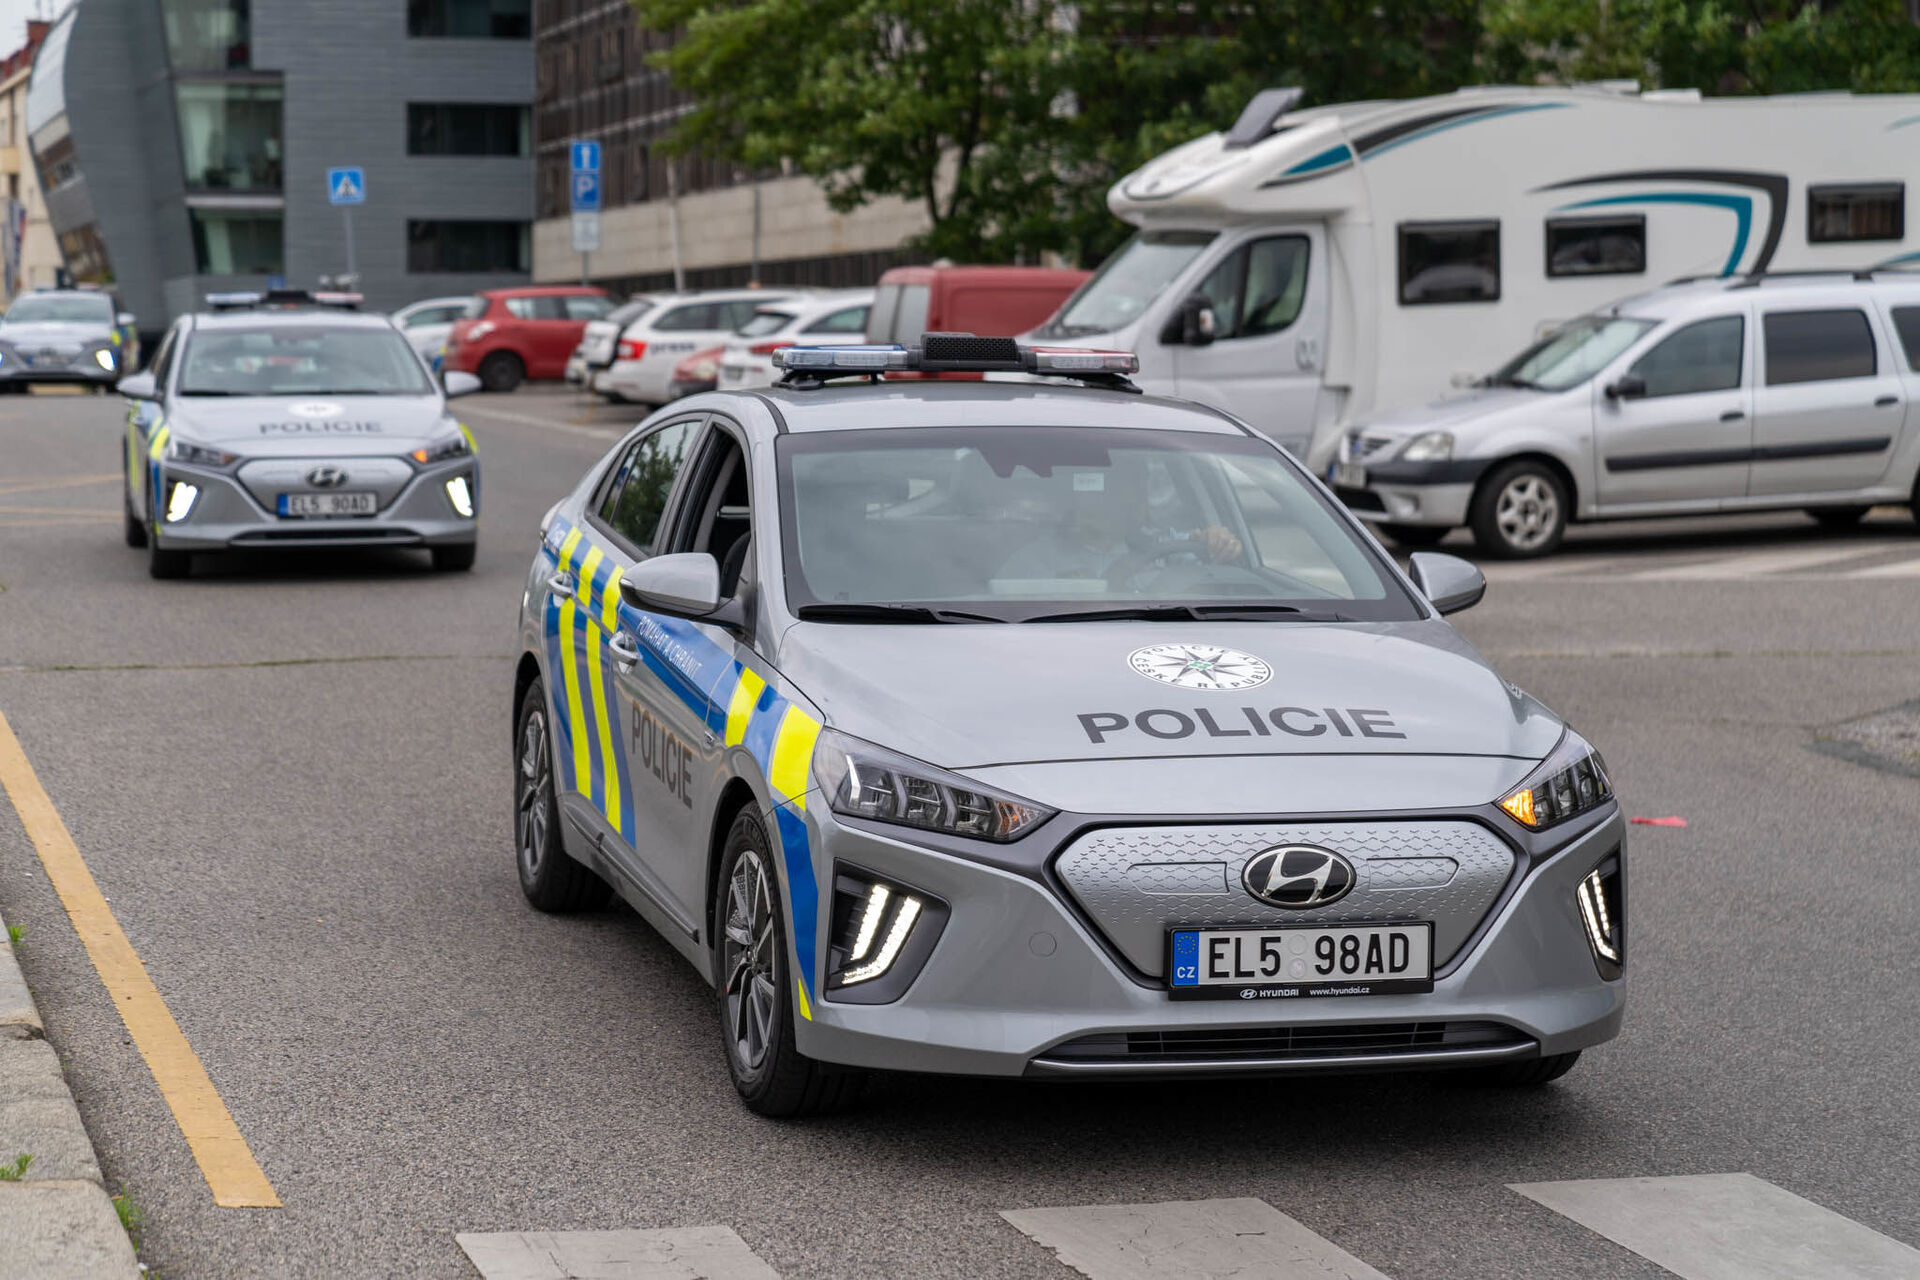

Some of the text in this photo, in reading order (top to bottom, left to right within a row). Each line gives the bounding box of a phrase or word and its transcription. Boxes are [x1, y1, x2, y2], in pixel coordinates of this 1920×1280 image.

[259, 421, 383, 434] POLICIE
[291, 494, 370, 512] EL5 90AD
[1077, 706, 1408, 744] POLICIE
[632, 701, 693, 809] POLICIE
[1177, 932, 1410, 979] CZ EL5 98AD
[1259, 986, 1371, 998] HYUNDAI www.hyundai.cz
